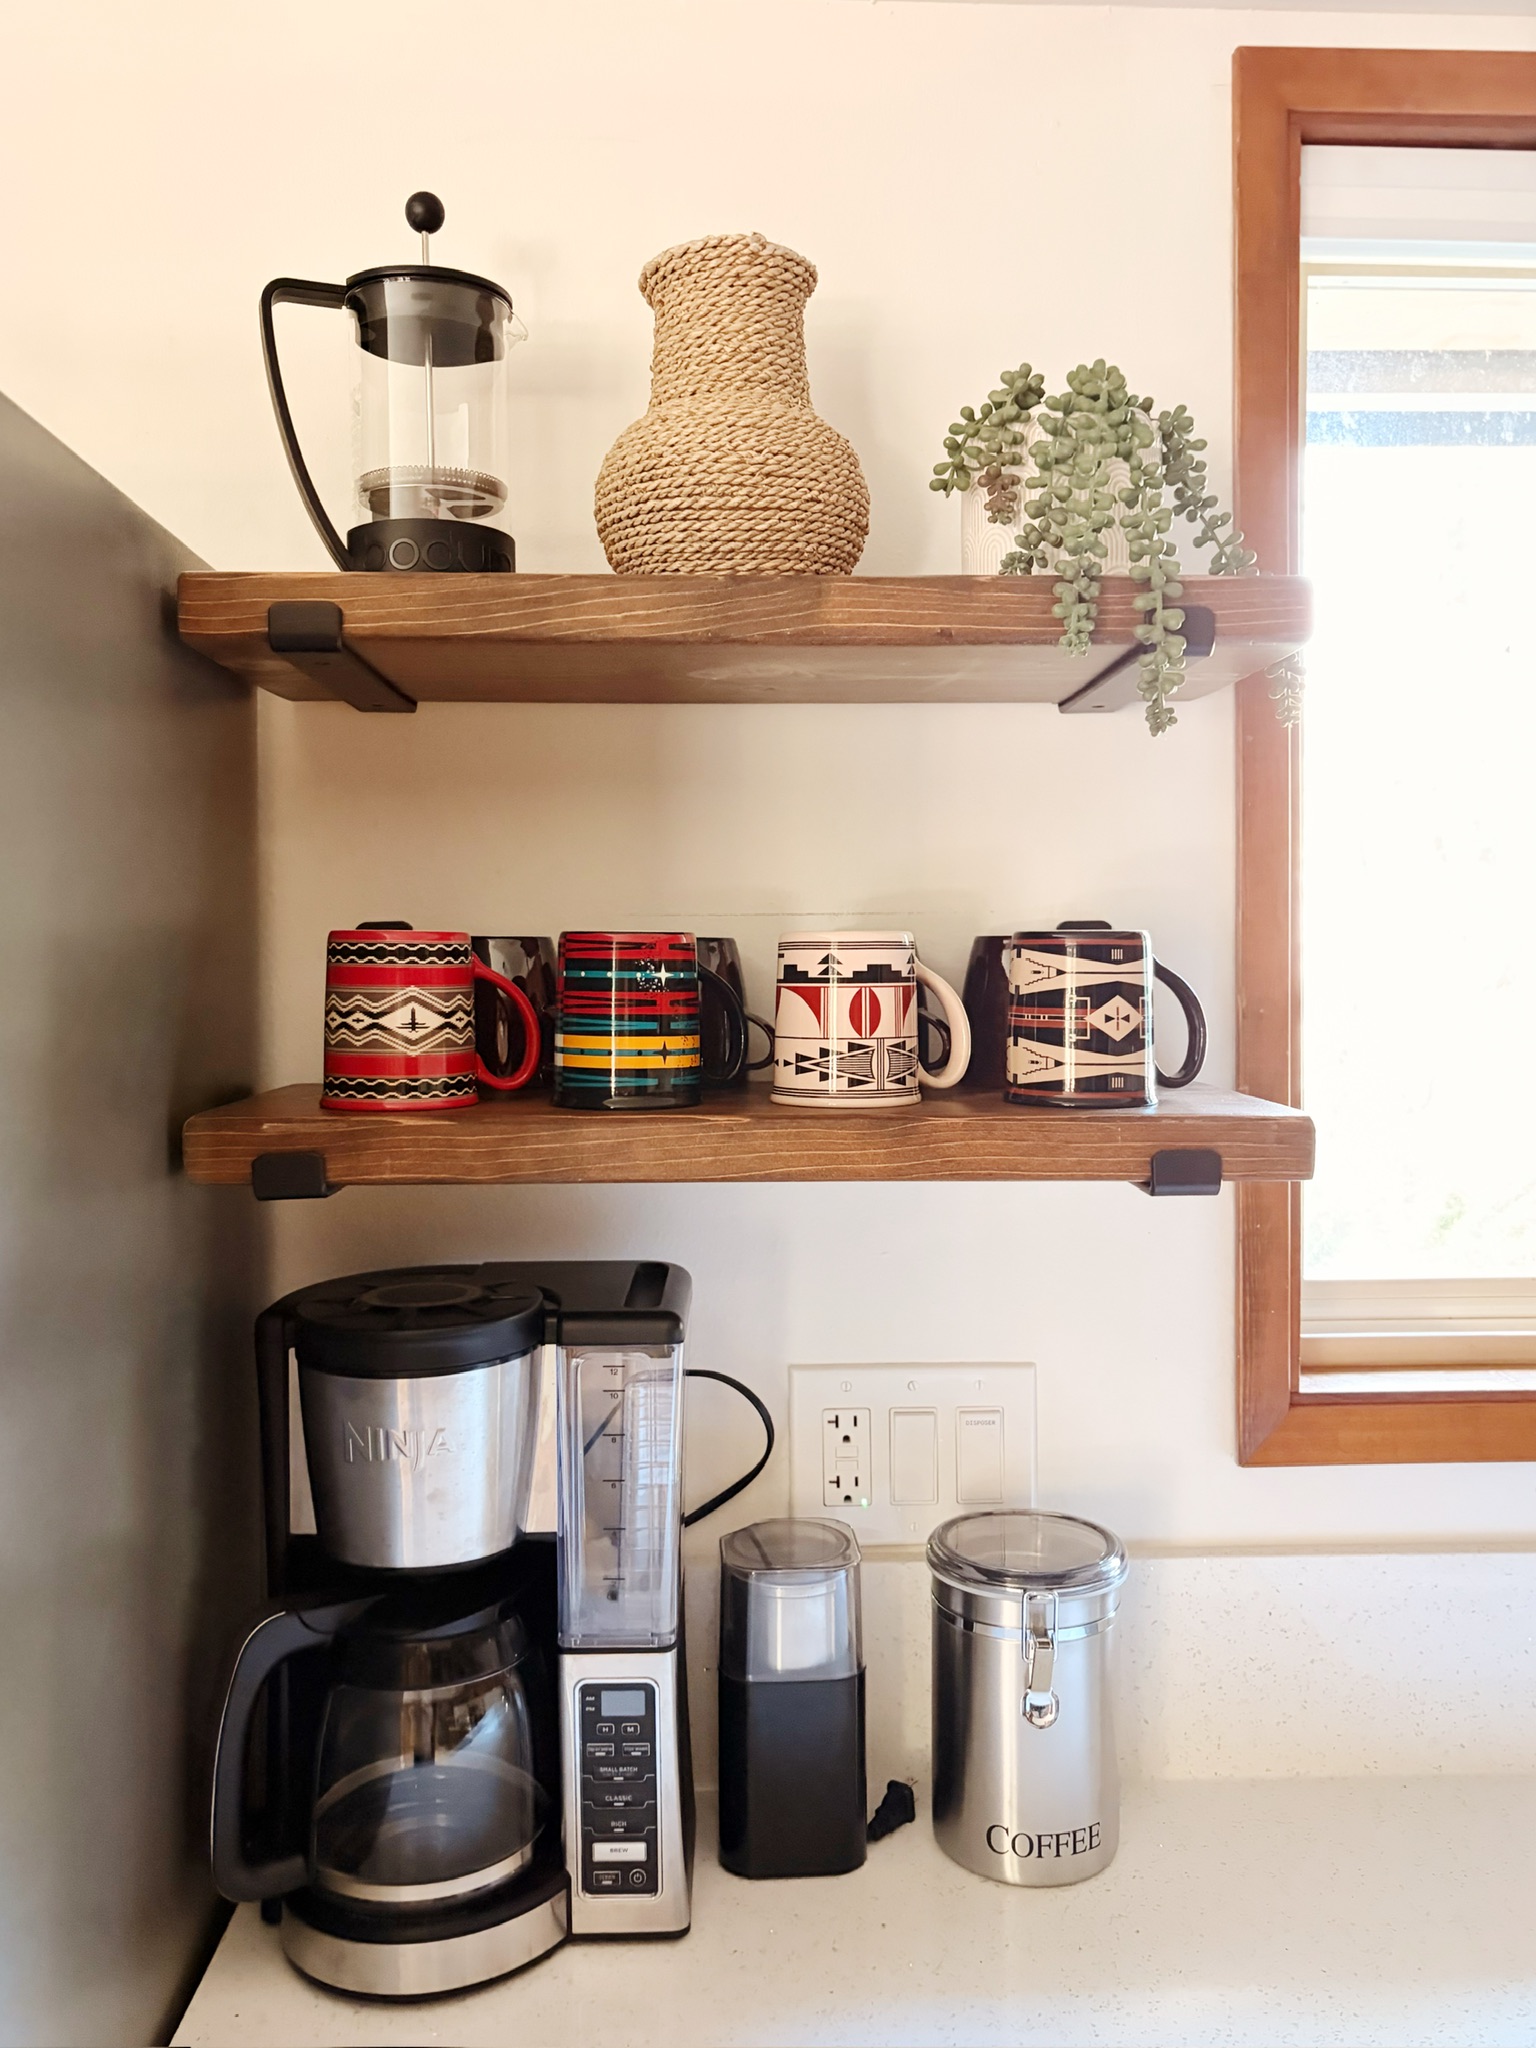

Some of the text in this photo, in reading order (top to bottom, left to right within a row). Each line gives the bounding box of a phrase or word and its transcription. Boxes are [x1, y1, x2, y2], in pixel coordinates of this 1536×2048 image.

[610, 1368, 619, 1376] 12
[342, 1420, 454, 1472] NINJA
[985, 1821, 1101, 1859] COFFEE
